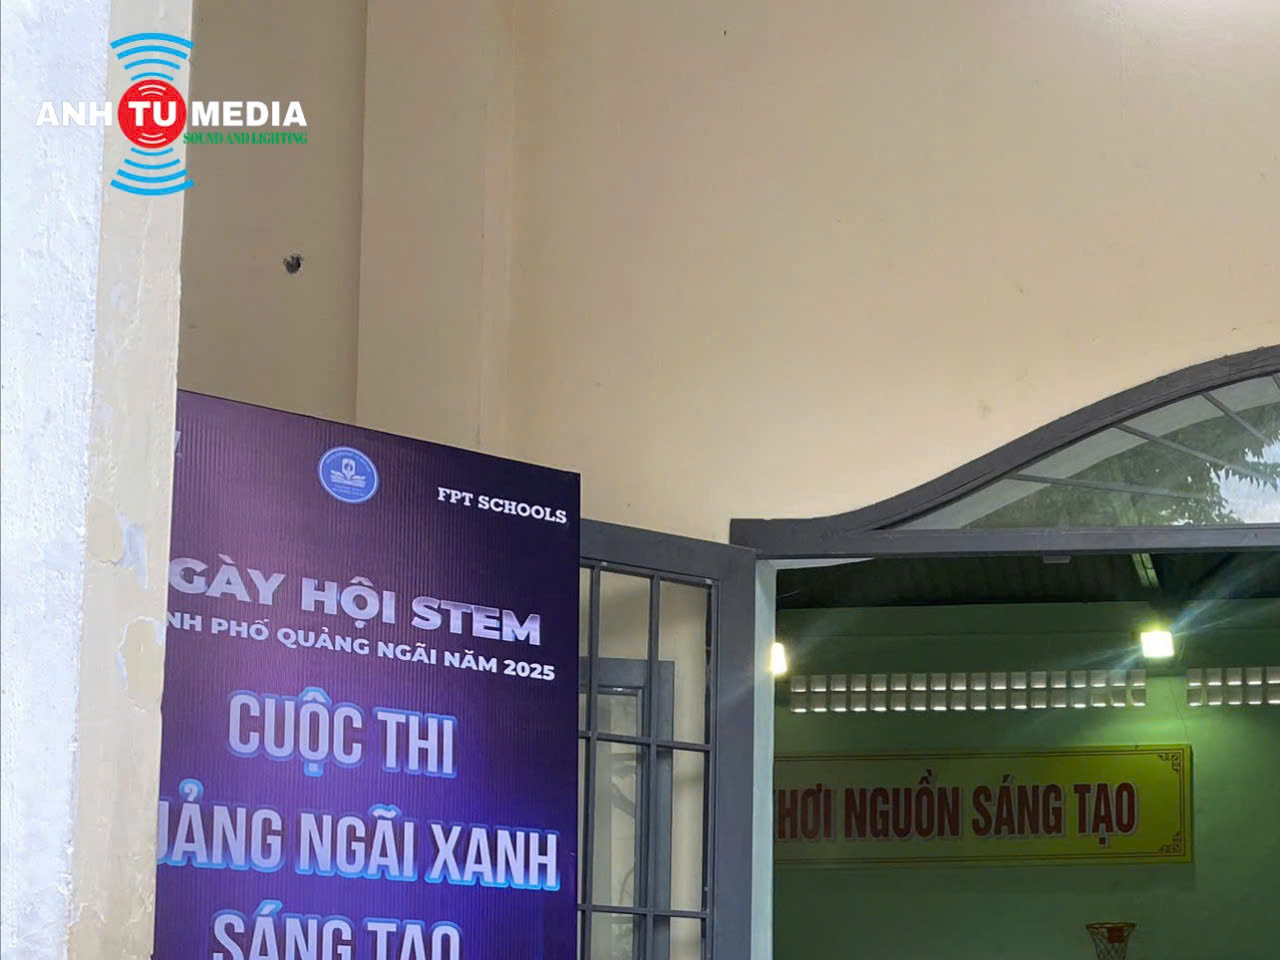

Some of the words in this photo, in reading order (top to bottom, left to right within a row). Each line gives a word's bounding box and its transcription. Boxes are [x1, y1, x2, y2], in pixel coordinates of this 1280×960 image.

[437, 486, 473, 507] FPT
[478, 494, 567, 524] SCHOOLS
[168, 553, 286, 605] GÀY
[301, 576, 396, 629] HỘI
[411, 596, 541, 646] STEM
[211, 618, 269, 641] PHỐ
[277, 626, 370, 656] QUẢNG
[377, 641, 437, 666] NGÃI
[444, 650, 497, 673] NĂM
[503, 658, 555, 682] 2025
[228, 688, 363, 776] CUỘC
[375, 708, 456, 777] THI
[157, 778, 284, 871] ẢNG
[296, 805, 416, 880] NGÃI
[426, 822, 559, 890] XANH
[777, 783, 833, 840] HƠI
[844, 769, 961, 838] NGUỒN
[971, 775, 1063, 837] SÁNG
[1073, 783, 1137, 847] TẠO
